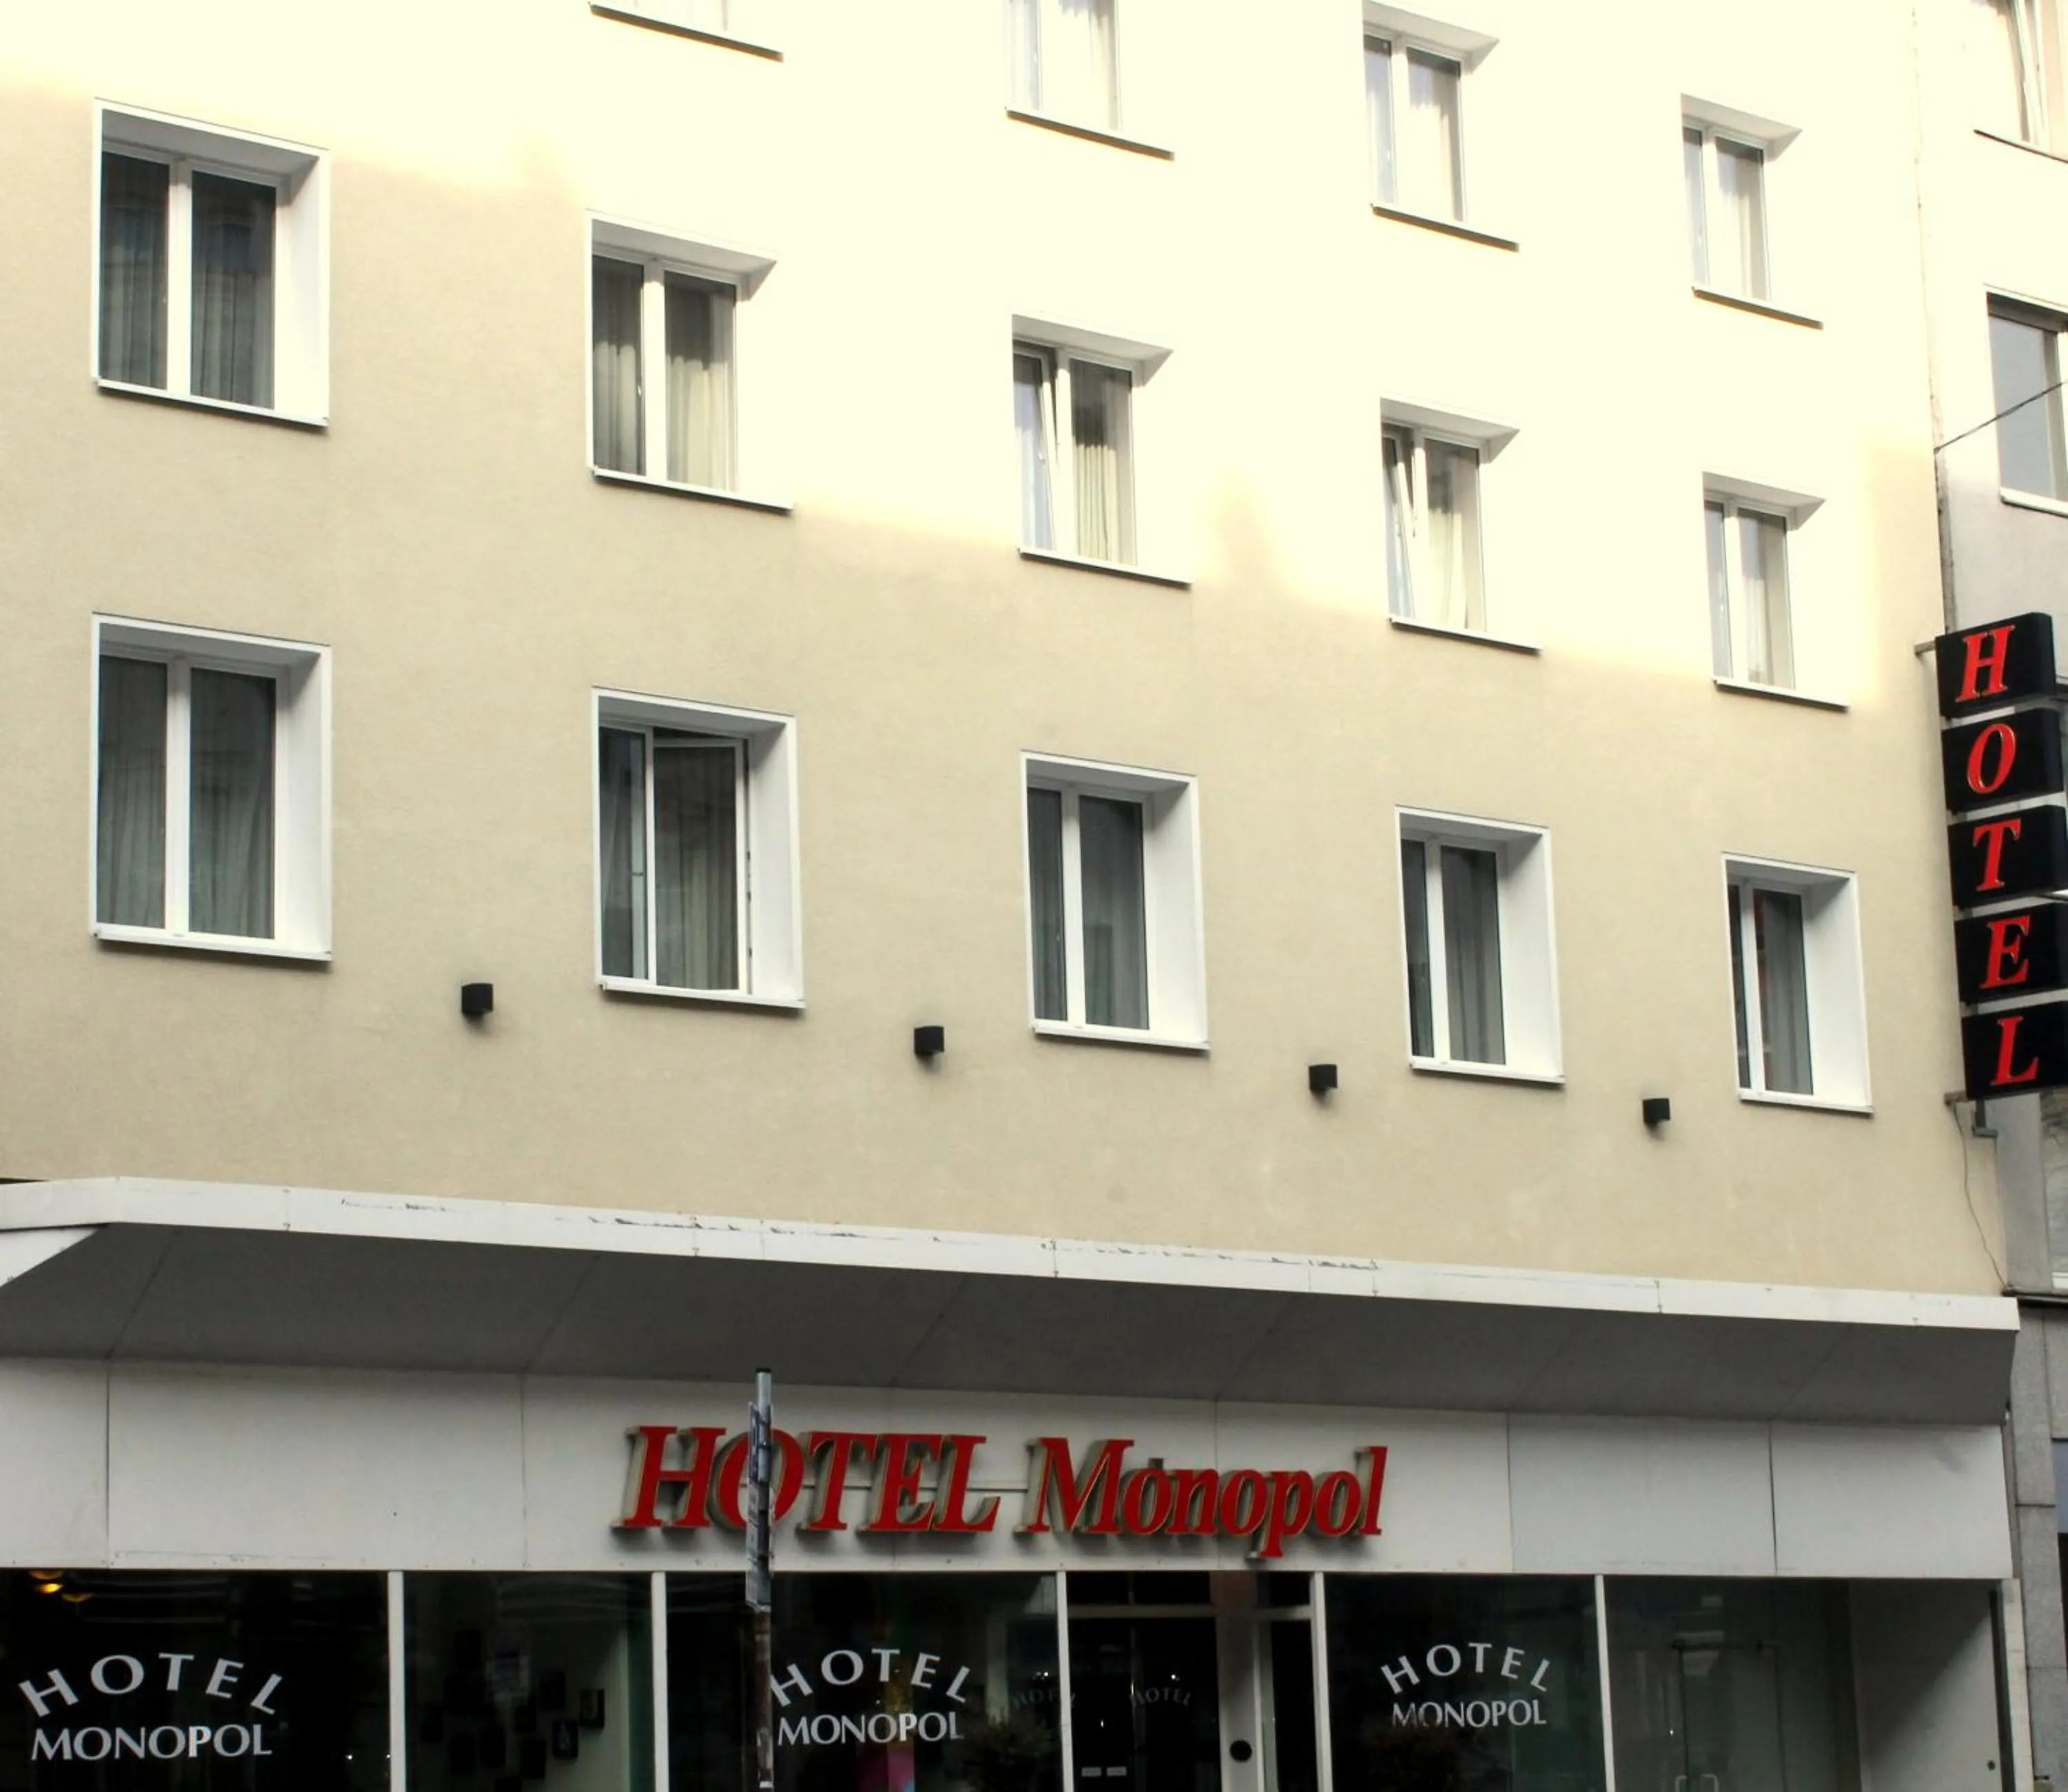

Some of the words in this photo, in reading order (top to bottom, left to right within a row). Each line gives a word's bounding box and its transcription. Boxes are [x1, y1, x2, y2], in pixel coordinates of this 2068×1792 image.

[1955, 624, 2038, 1087] HOTEL
[615, 1425, 1002, 1531] HOTEL
[1016, 1437, 1388, 1559] Monopol
[19, 1652, 283, 1718] HOTEL
[769, 1648, 970, 1707] HOTEL
[1380, 1642, 1550, 1694] HOTEL
[778, 1711, 964, 1747] MONOPOL
[1392, 1698, 1547, 1729] MONOPOL
[31, 1724, 272, 1761] MONOPOL
